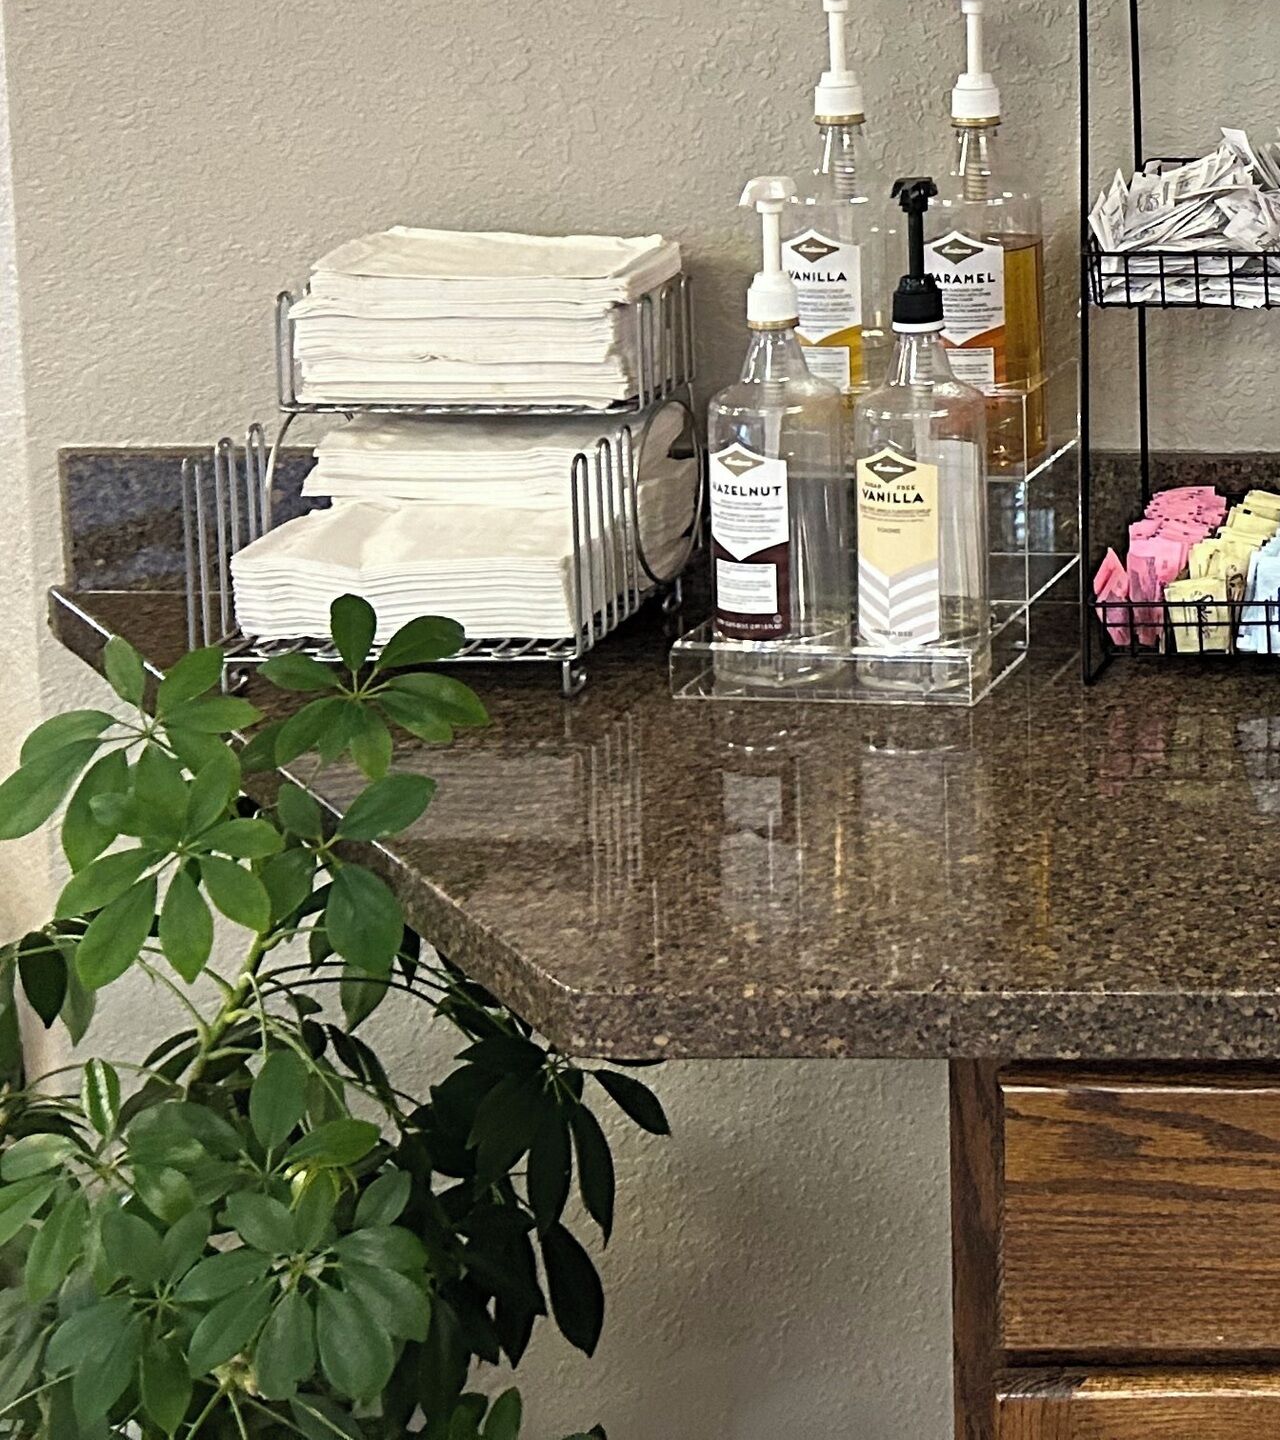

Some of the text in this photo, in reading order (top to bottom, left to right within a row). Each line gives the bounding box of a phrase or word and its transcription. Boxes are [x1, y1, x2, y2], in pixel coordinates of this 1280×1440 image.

[788, 270, 847, 282] VANILLA
[934, 273, 996, 284] ARAMEL
[862, 488, 924, 503] VANILLA
